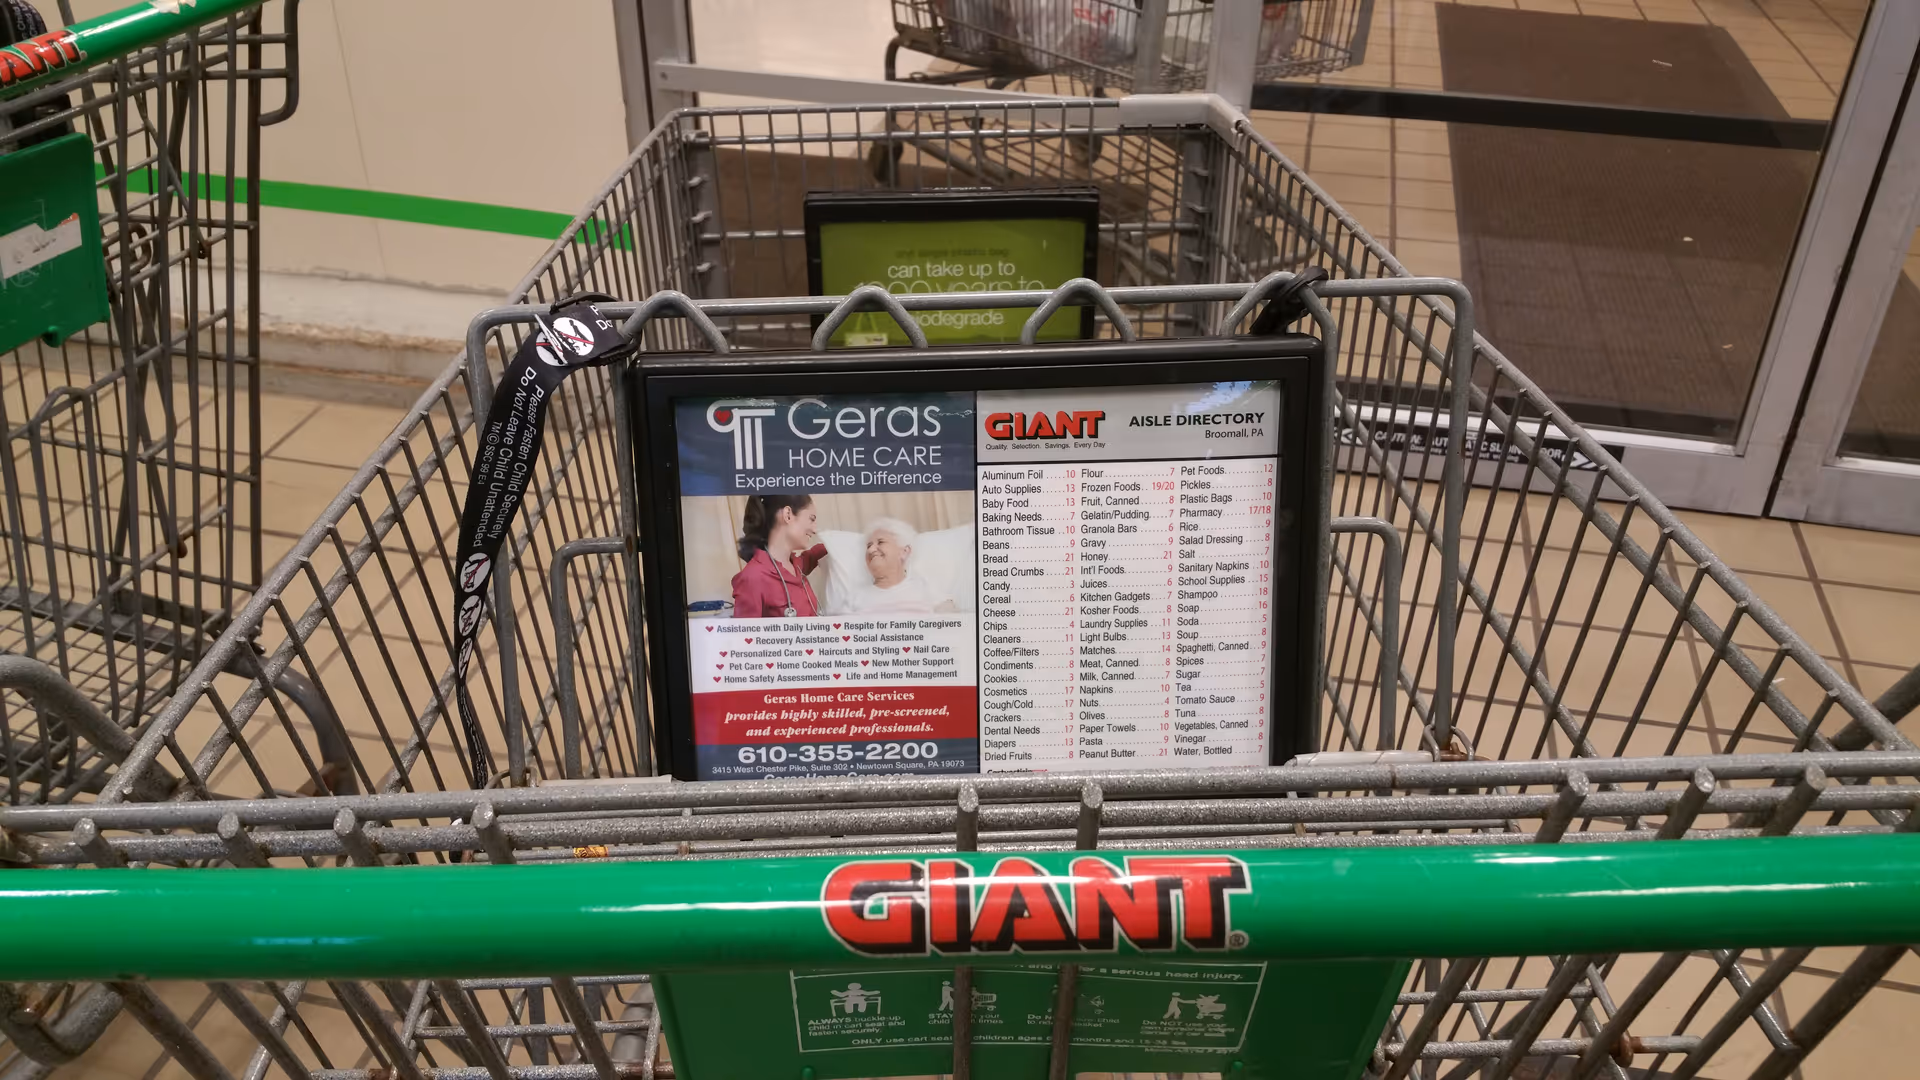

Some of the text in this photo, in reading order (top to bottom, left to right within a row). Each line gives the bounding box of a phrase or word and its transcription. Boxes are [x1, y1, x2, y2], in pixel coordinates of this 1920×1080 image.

[888, 261, 1015, 278] can take up to
[915, 312, 1004, 328] iodegrade
[788, 398, 941, 439] Geras
[1130, 412, 1264, 428] AISLE DIRECTORY
[984, 410, 1105, 440] GIANT
[1205, 427, 1263, 440] Broomall, PA
[1373, 429, 1422, 445] CAUTIN:
[986, 441, 1105, 451] Quality. Selection. Savings. Every Day
[473, 366, 537, 547] Do Not Leave Child Unattended
[487, 385, 544, 539] Please Fasten Child Securely
[789, 446, 941, 468] HOME CARE
[982, 469, 1043, 481] Aluminum Foil
[1181, 465, 1195, 476] Pet
[736, 471, 941, 490] Experience the Difference
[982, 484, 1002, 495] Auto
[1082, 482, 1111, 493] Frozen
[1153, 481, 1174, 491] 19/20
[983, 497, 1028, 511] Baby Food
[1082, 495, 1139, 507] Fruit, Canned
[1180, 492, 1232, 505] Plastic Bags
[983, 512, 1011, 525] Baking
[983, 525, 1054, 537] Bathroom Tissue
[1081, 523, 1137, 535] Granola Bars
[1179, 533, 1243, 546] Salad Dressing
[983, 566, 1044, 578] Bread Crumbs
[1179, 560, 1249, 574] Sanitary Napkins
[1178, 574, 1245, 587] School Supplies
[1081, 591, 1150, 604] Kitchen Gadgets
[717, 622, 830, 633] Assistance with Daily Living
[844, 619, 961, 632] Respite for Family Caregivers
[1081, 618, 1148, 631] Laundry Supplies
[756, 635, 839, 646] Recovery Assistance
[854, 633, 923, 643] Social Assistance
[1080, 632, 1100, 644] Light
[731, 648, 802, 658] Personalized Care
[819, 646, 899, 656] Haircuts and Styling
[914, 644, 949, 654] Nail Care
[984, 647, 1039, 658] Coffee/Filters
[1177, 642, 1215, 655] Spaghetti,
[730, 662, 763, 671] Pet Care
[777, 659, 858, 670] Home Cooked Meals
[872, 657, 953, 668] New Mother Support
[725, 673, 830, 684] Home Safety Assessments
[847, 669, 957, 681] Life and Home Management
[764, 690, 914, 704] Geras Home Care Services
[984, 686, 1027, 697] Cosmetics
[1175, 695, 1206, 705] Tomato
[724, 706, 949, 724] provides highly skilled, pre-screened,
[746, 722, 933, 738] and experienced professionals.
[1175, 719, 1248, 733] Vegetables, Canned
[738, 742, 938, 764] 610-355-2200
[985, 751, 1032, 762] Dried Fruits
[1080, 749, 1108, 759] Peanut
[1174, 745, 1232, 756] Water, Bottled
[712, 759, 964, 774] 3415 West Chester Pike, Suite 302 Newtown Square, PA 19073
[821, 855, 1252, 957] GIANT
[808, 1016, 851, 1026] ALWAYS
[852, 1037, 882, 1046] ONLY
